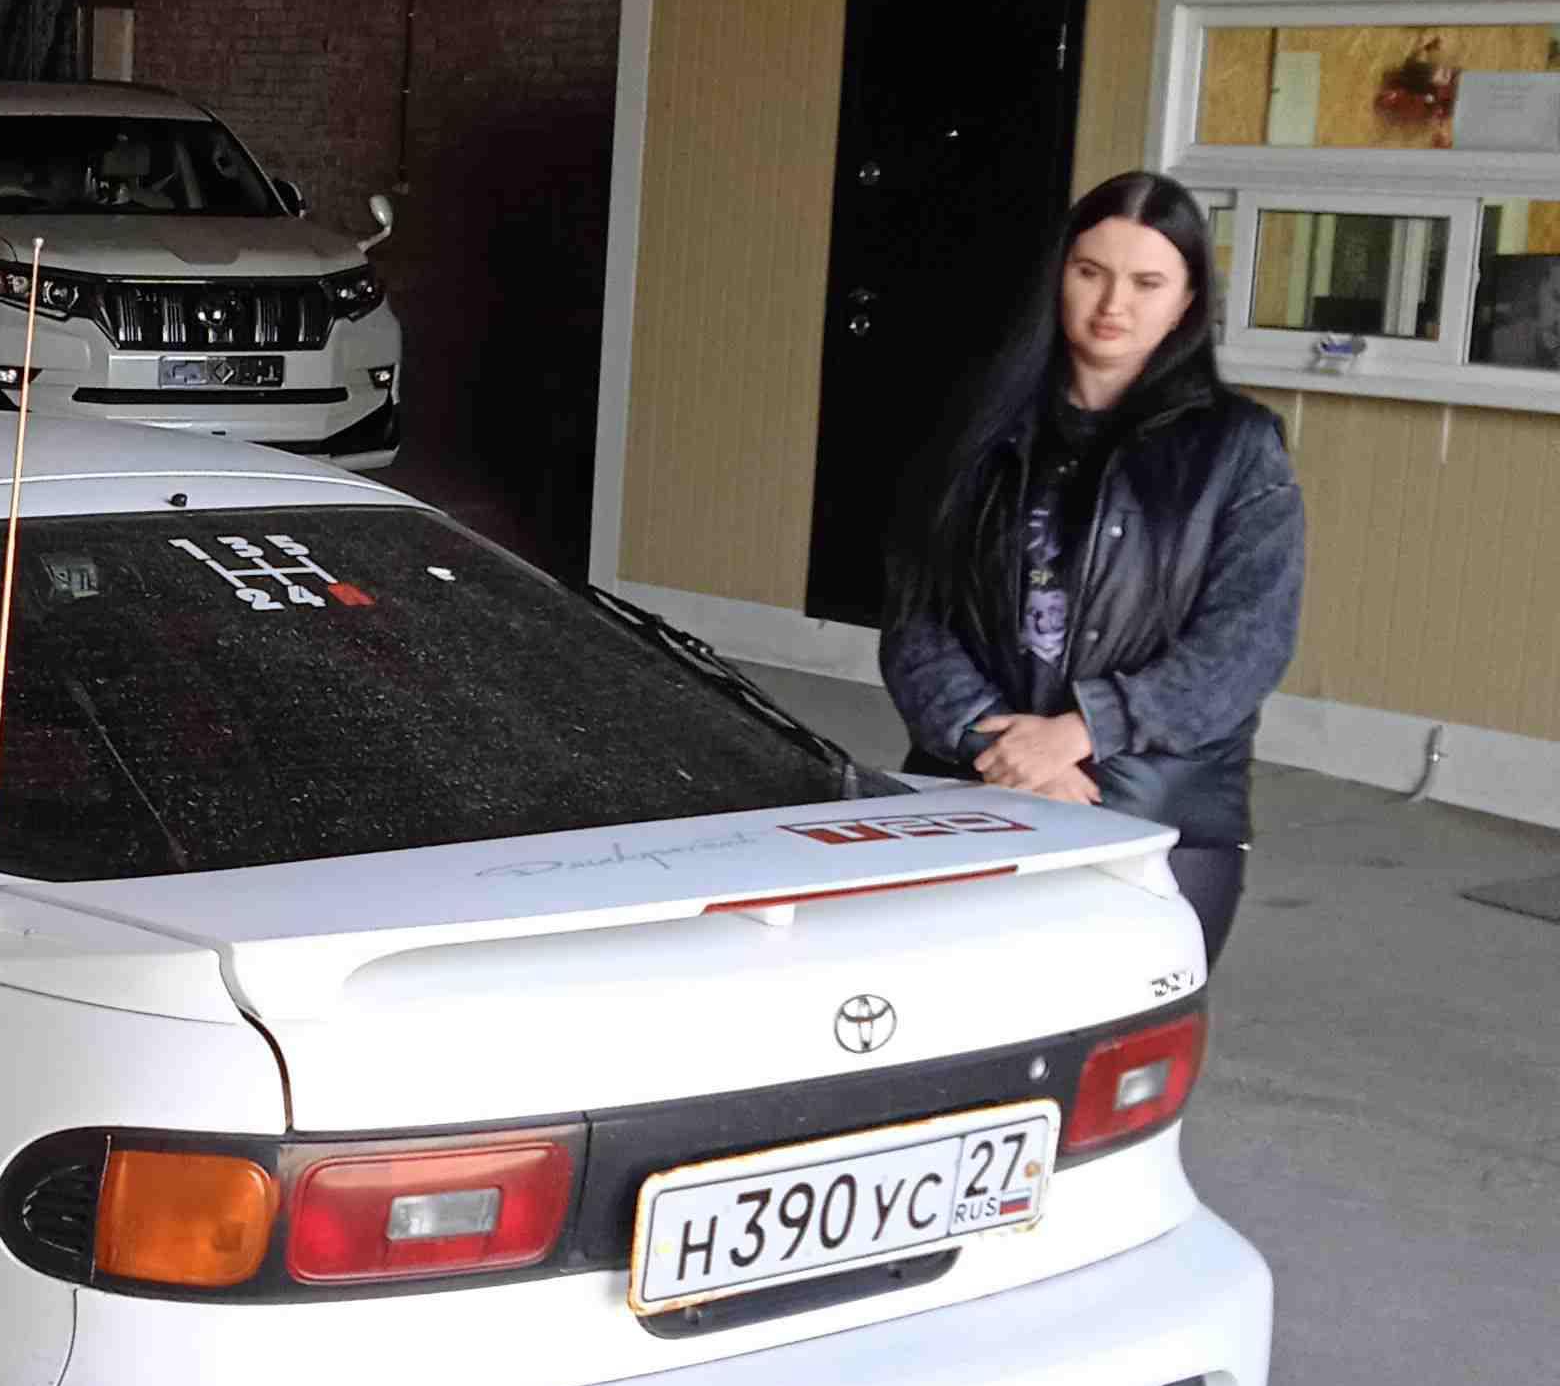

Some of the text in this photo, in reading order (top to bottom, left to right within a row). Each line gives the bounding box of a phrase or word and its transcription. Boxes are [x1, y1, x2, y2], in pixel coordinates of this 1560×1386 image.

[168, 535, 309, 560] 1 3 5
[236, 588, 285, 611] 2
[288, 585, 326, 607] 4
[677, 1132, 1028, 1282] Н390УС 27
[953, 1195, 998, 1225] RUS
